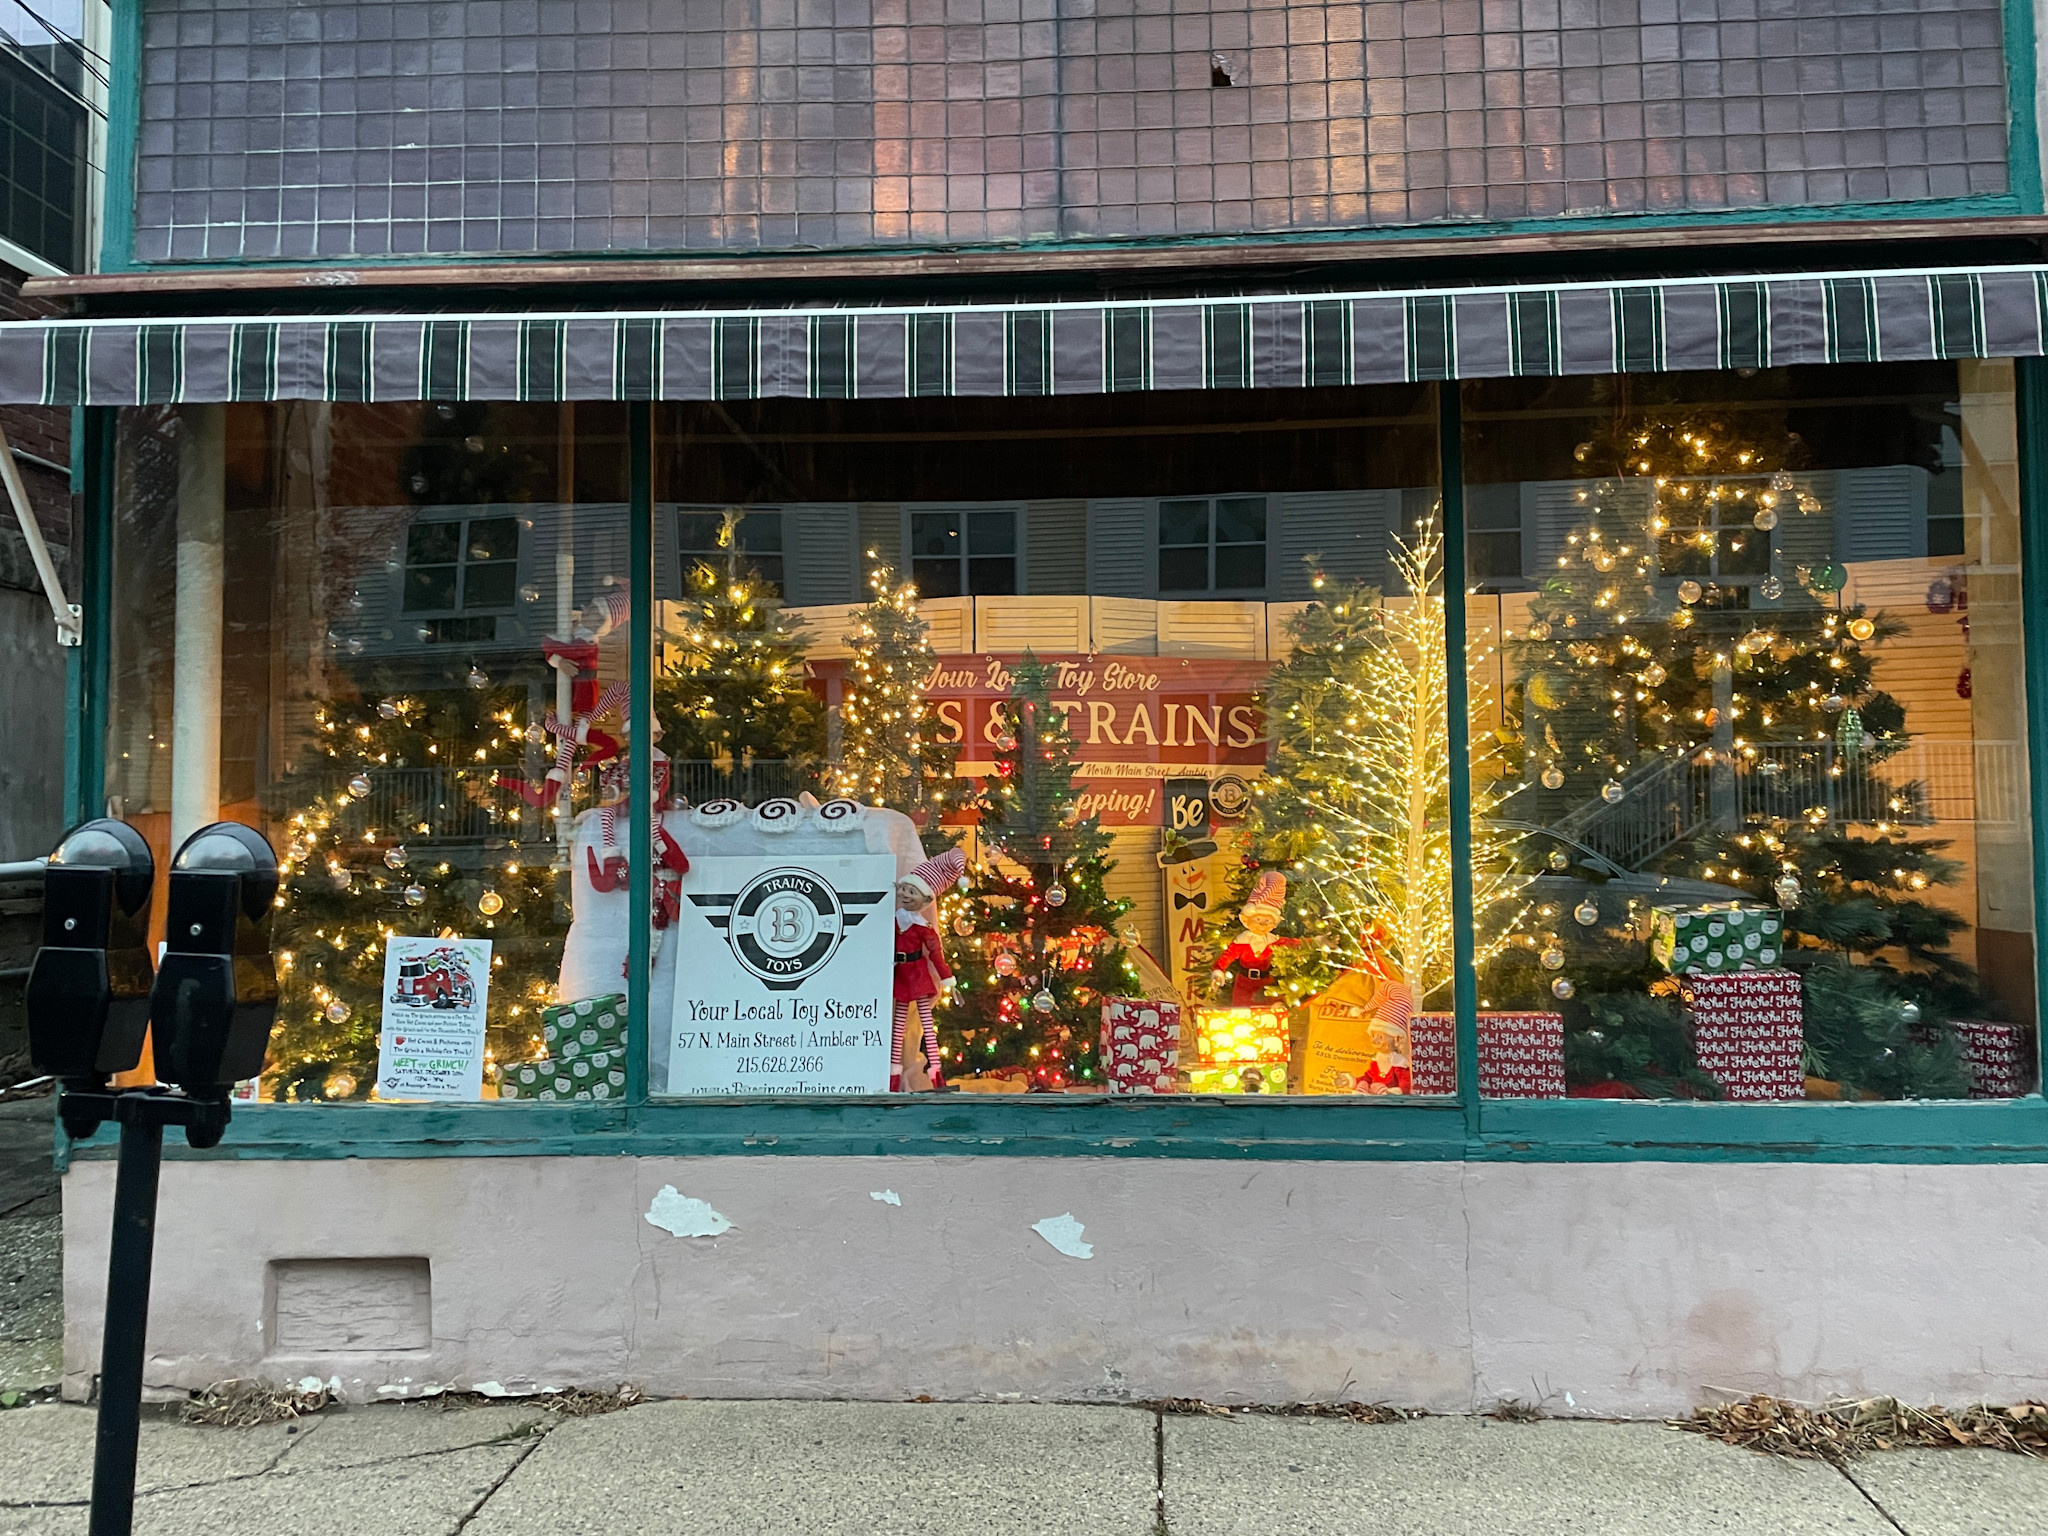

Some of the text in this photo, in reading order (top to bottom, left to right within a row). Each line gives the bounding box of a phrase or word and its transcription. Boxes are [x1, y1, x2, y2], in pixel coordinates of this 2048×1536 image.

[923, 662, 979, 691] Your
[1052, 661, 1096, 697] Toy
[1102, 662, 1161, 691] Store
[1050, 701, 1256, 749] TRAINS
[1086, 763, 1112, 776] North
[1115, 764, 1142, 777] Main
[1076, 788, 1155, 820] pping!
[1172, 795, 1204, 831] Be
[763, 878, 814, 894] TRAINS
[770, 904, 804, 943] B
[766, 958, 803, 972] TOYS
[688, 998, 878, 1026] Your Local Toy Store!
[678, 1030, 884, 1049] 57 N. Main Street Ambler PA
[393, 1058, 419, 1068] MEET
[429, 1059, 469, 1071] GRINCH!
[736, 1056, 824, 1074] 215.628.2366
